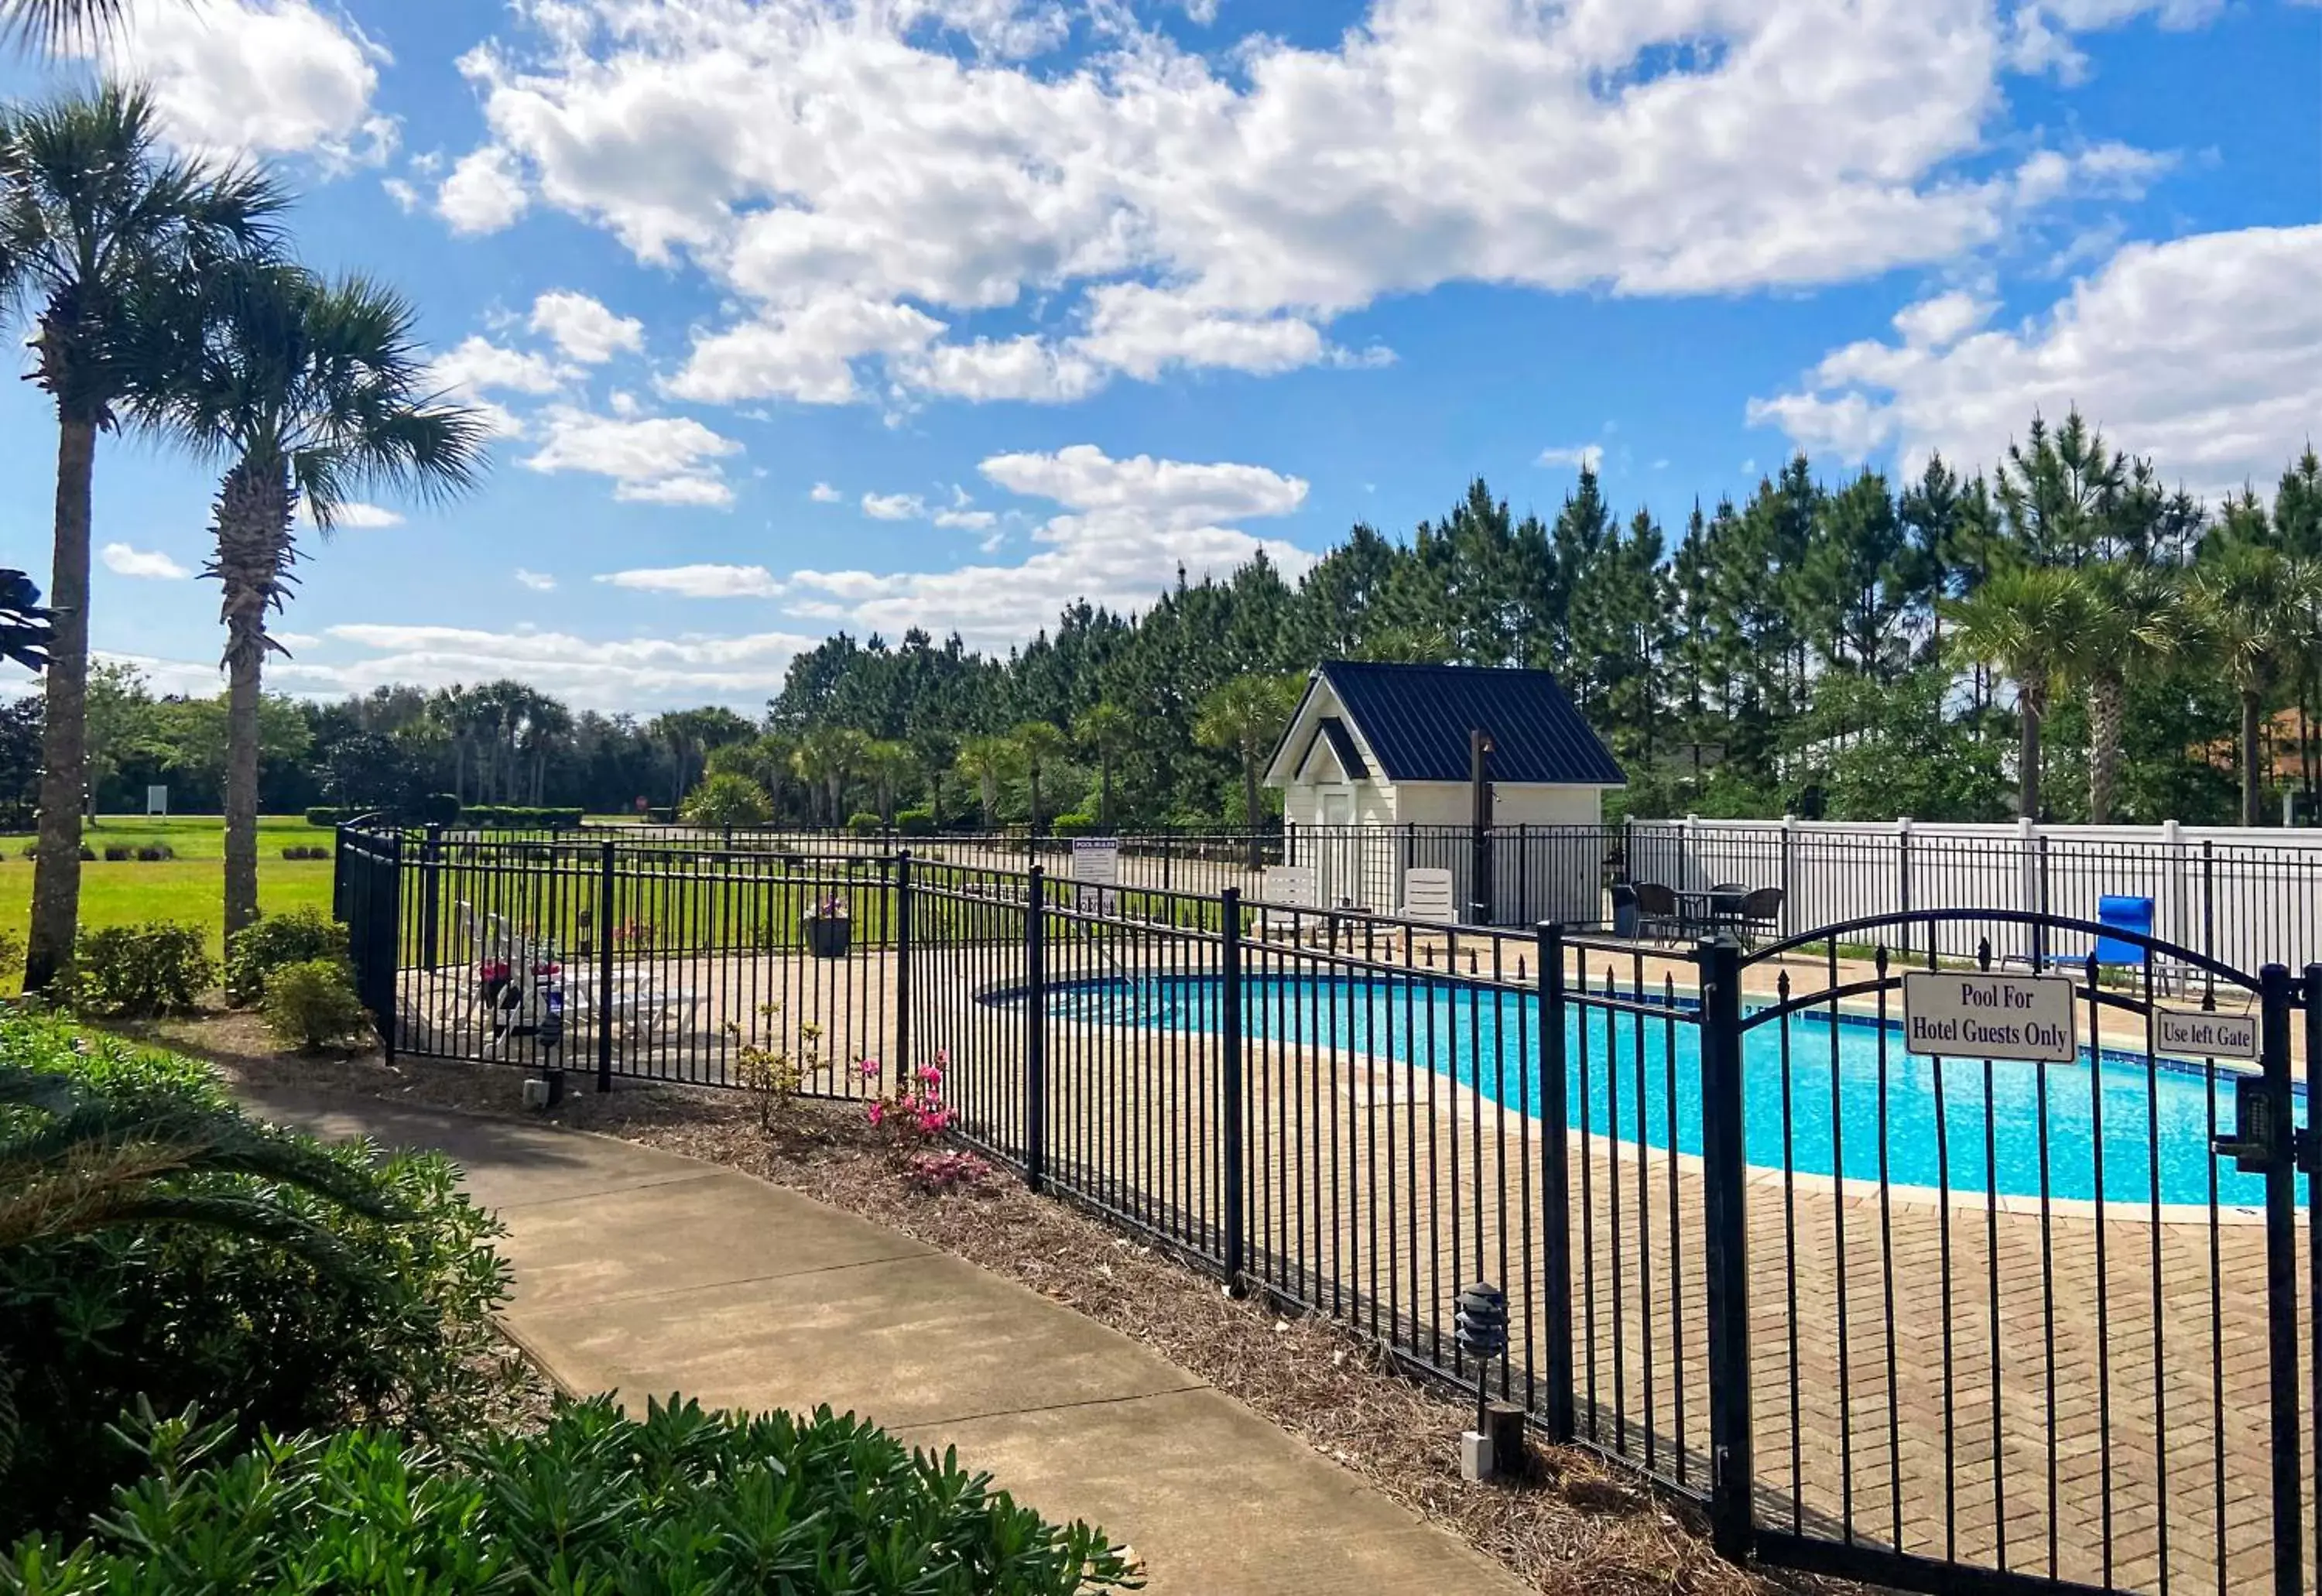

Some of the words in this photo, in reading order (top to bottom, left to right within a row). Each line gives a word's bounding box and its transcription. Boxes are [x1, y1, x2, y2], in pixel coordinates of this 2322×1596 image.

[1961, 983, 1998, 1007] Pool
[2003, 985, 2034, 1009] For
[1913, 1016, 1957, 1041] Hotel
[1963, 1018, 2019, 1044] Guests
[2024, 1022, 2067, 1053] Only
[2164, 1022, 2188, 1042] Use
[2191, 1024, 2213, 1044] left
[2218, 1026, 2250, 1046] Gate
